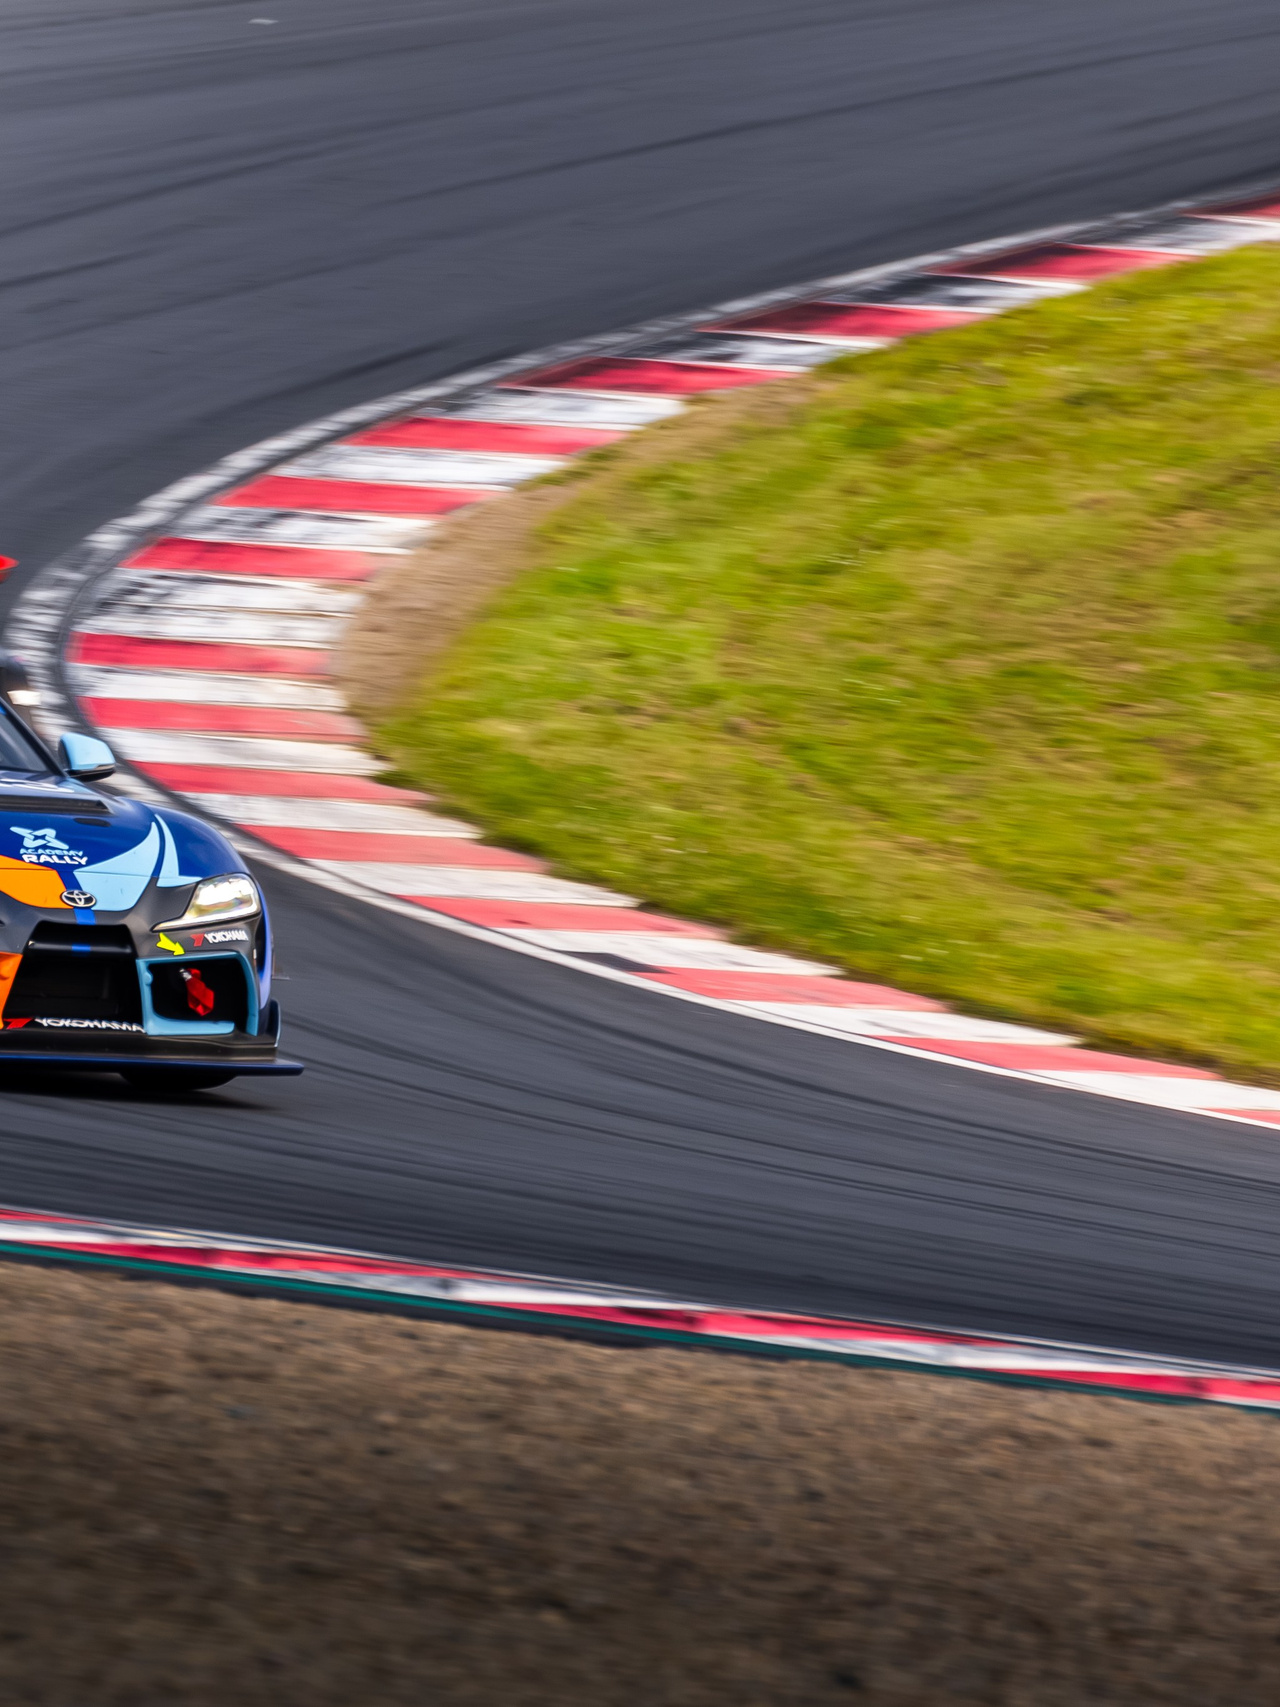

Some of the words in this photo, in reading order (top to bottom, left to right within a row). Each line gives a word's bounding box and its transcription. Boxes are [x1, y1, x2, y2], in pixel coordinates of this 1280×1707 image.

[20, 848, 83, 857] ACADEMY
[22, 855, 88, 865] RALLY
[204, 930, 249, 943] YOKOHAMA
[35, 1018, 146, 1034] YOKOHAMA
